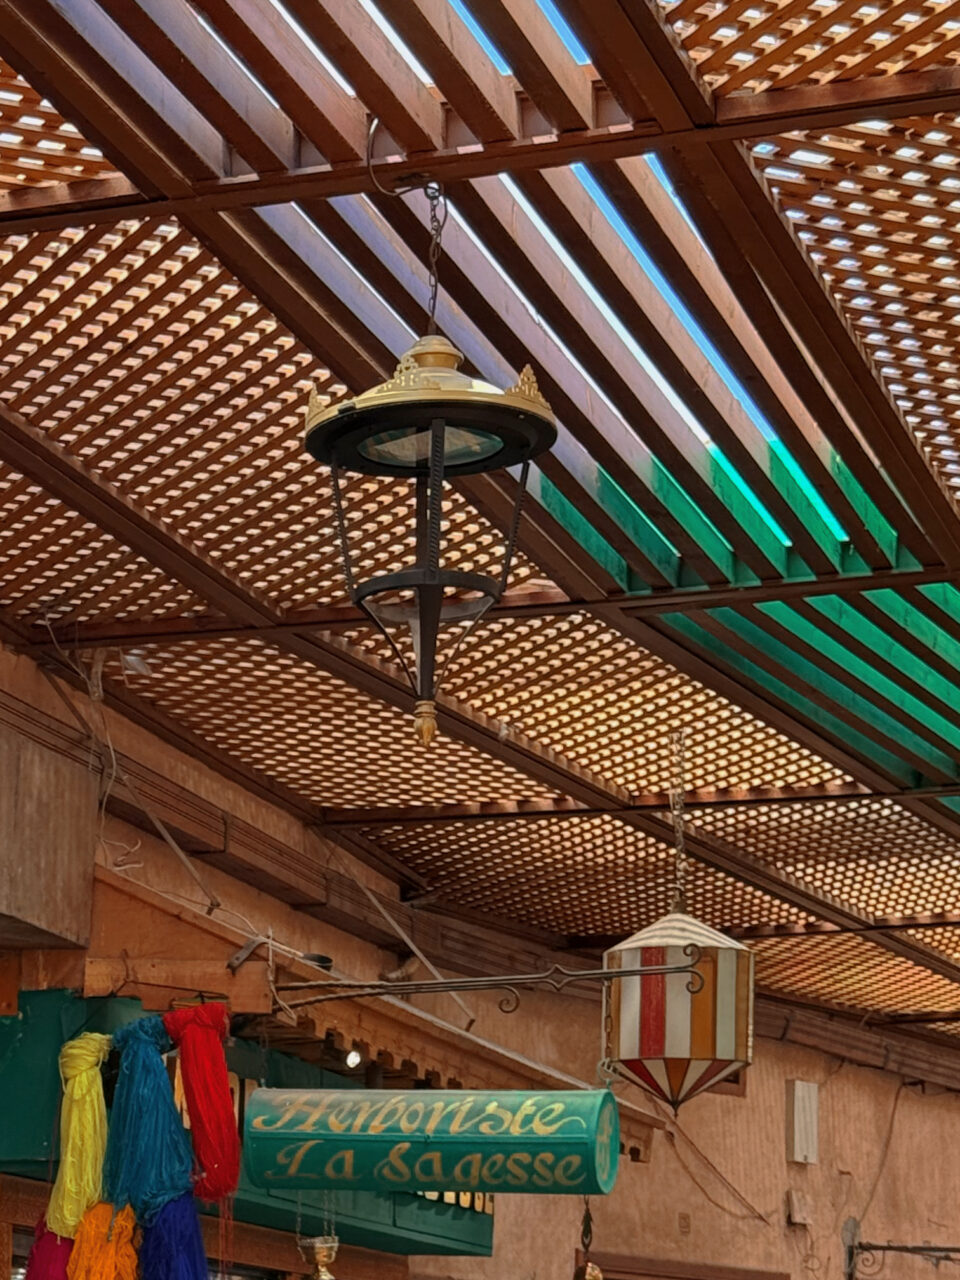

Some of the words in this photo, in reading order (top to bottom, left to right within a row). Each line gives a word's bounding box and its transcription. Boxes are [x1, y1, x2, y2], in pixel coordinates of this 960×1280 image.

[252, 1094, 587, 1136] Herboriste
[265, 1139, 364, 1180] La
[374, 1141, 587, 1188] Sagesse
